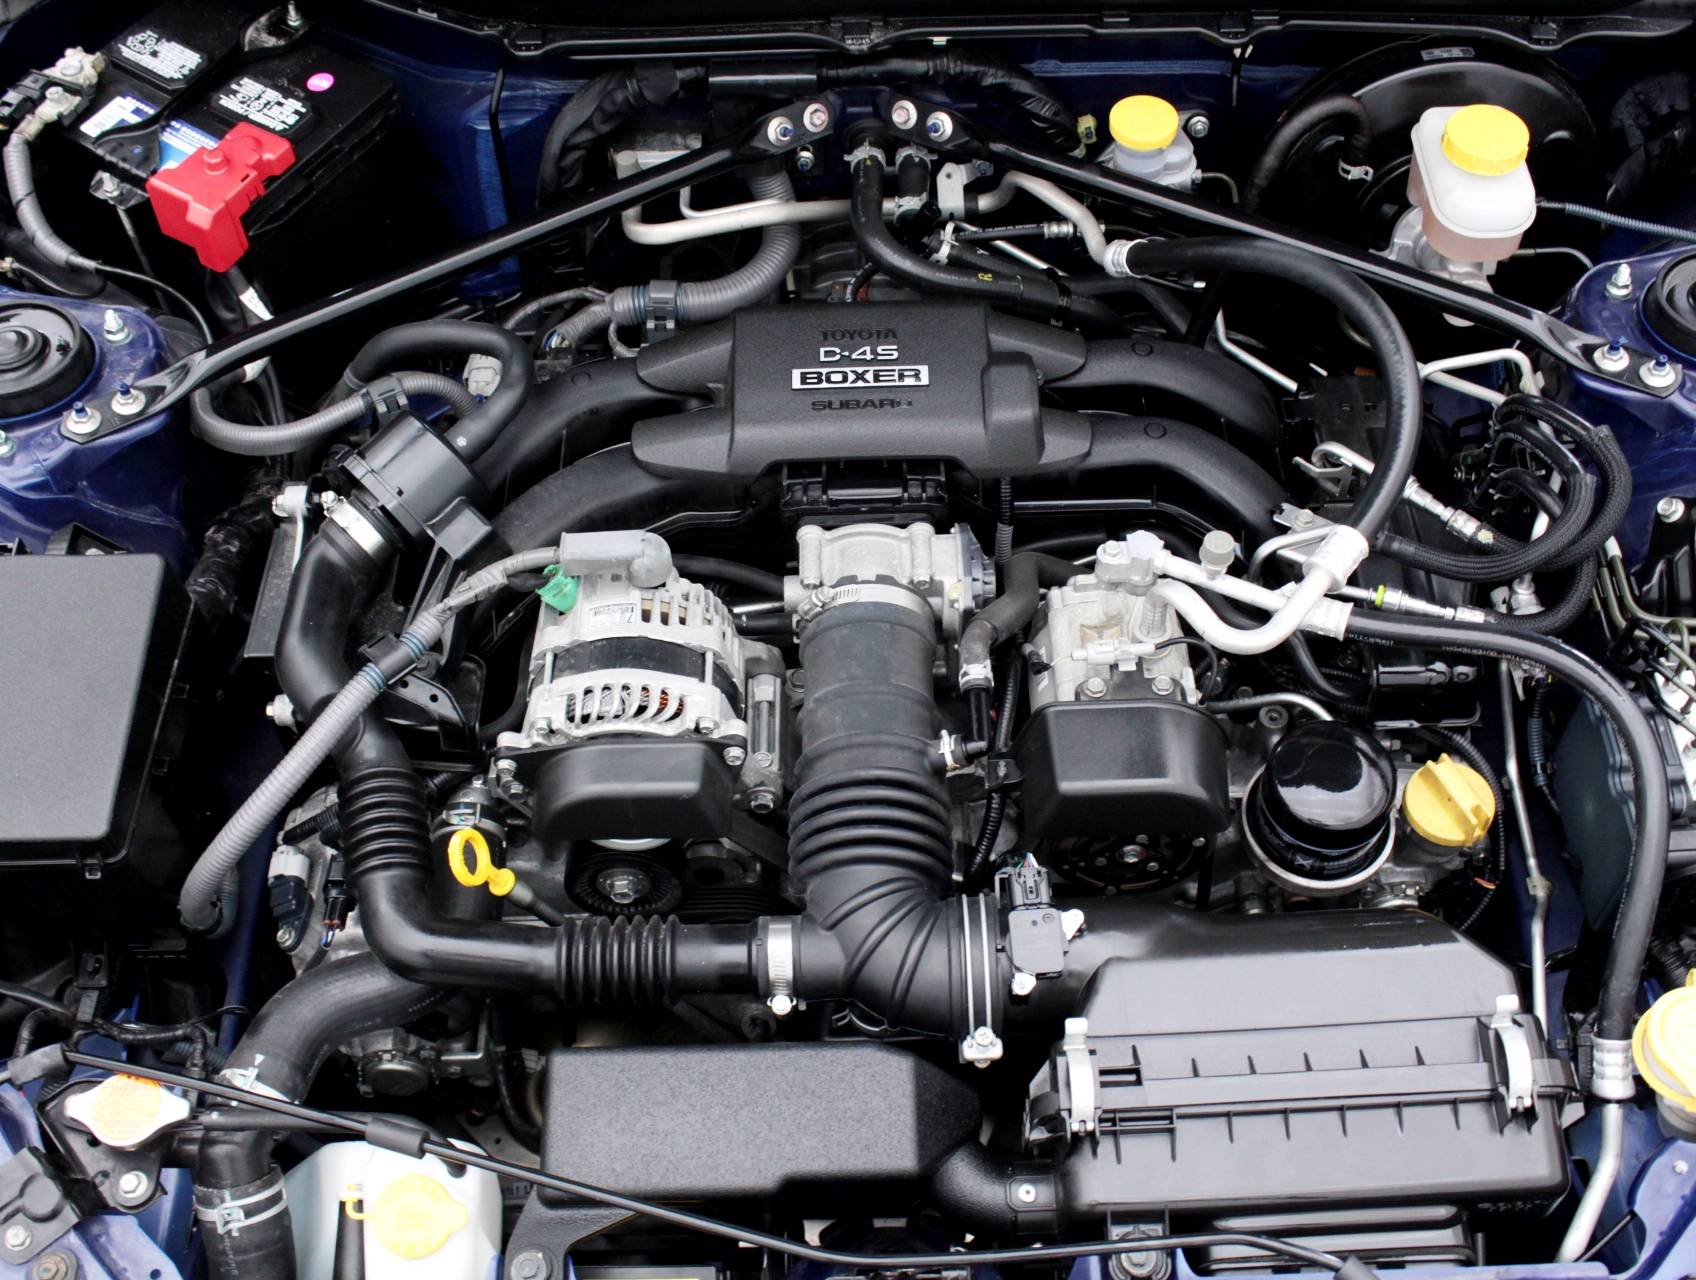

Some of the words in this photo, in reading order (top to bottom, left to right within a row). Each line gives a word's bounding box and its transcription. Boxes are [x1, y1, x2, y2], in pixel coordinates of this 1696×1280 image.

[819, 327, 898, 341] TOYOTA
[819, 345, 899, 362] D-4S
[800, 368, 922, 386] BOXER
